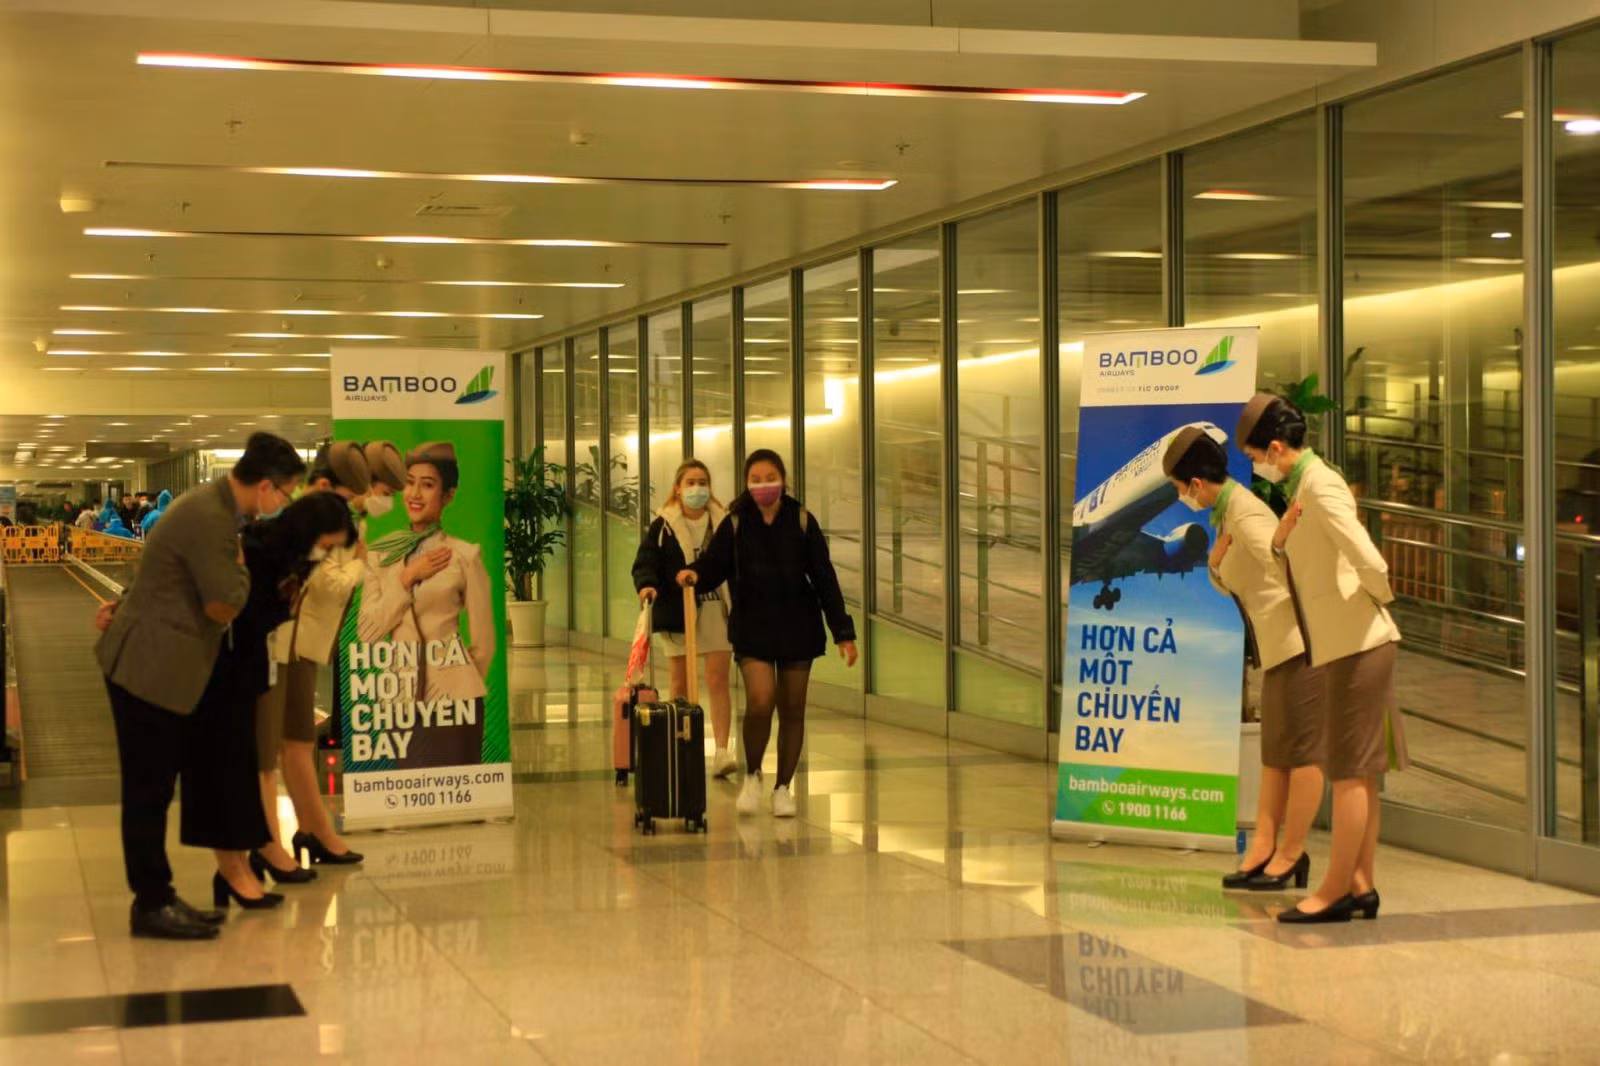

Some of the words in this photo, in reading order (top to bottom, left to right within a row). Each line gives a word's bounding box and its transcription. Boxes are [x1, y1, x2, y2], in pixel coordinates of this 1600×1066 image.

[1099, 349, 1198, 368] BAMBOO
[1099, 369, 1135, 377] AIRWAYS
[343, 376, 457, 394] BAMBOO
[345, 394, 388, 402] AIRWAYS
[1081, 624, 1136, 652] HƠN
[1143, 618, 1177, 654] CẢ
[349, 640, 419, 670] HƠN
[1077, 684, 1181, 723] CHUYẾN
[352, 731, 413, 762] BAY
[1075, 725, 1125, 753] BAY
[353, 771, 505, 793] bambooairways.com
[1069, 775, 1224, 803] bambooairways.com
[402, 792, 436, 807] 1900
[440, 790, 472, 806] 1166
[1118, 801, 1150, 818] 1900
[1155, 803, 1188, 821] 1166
